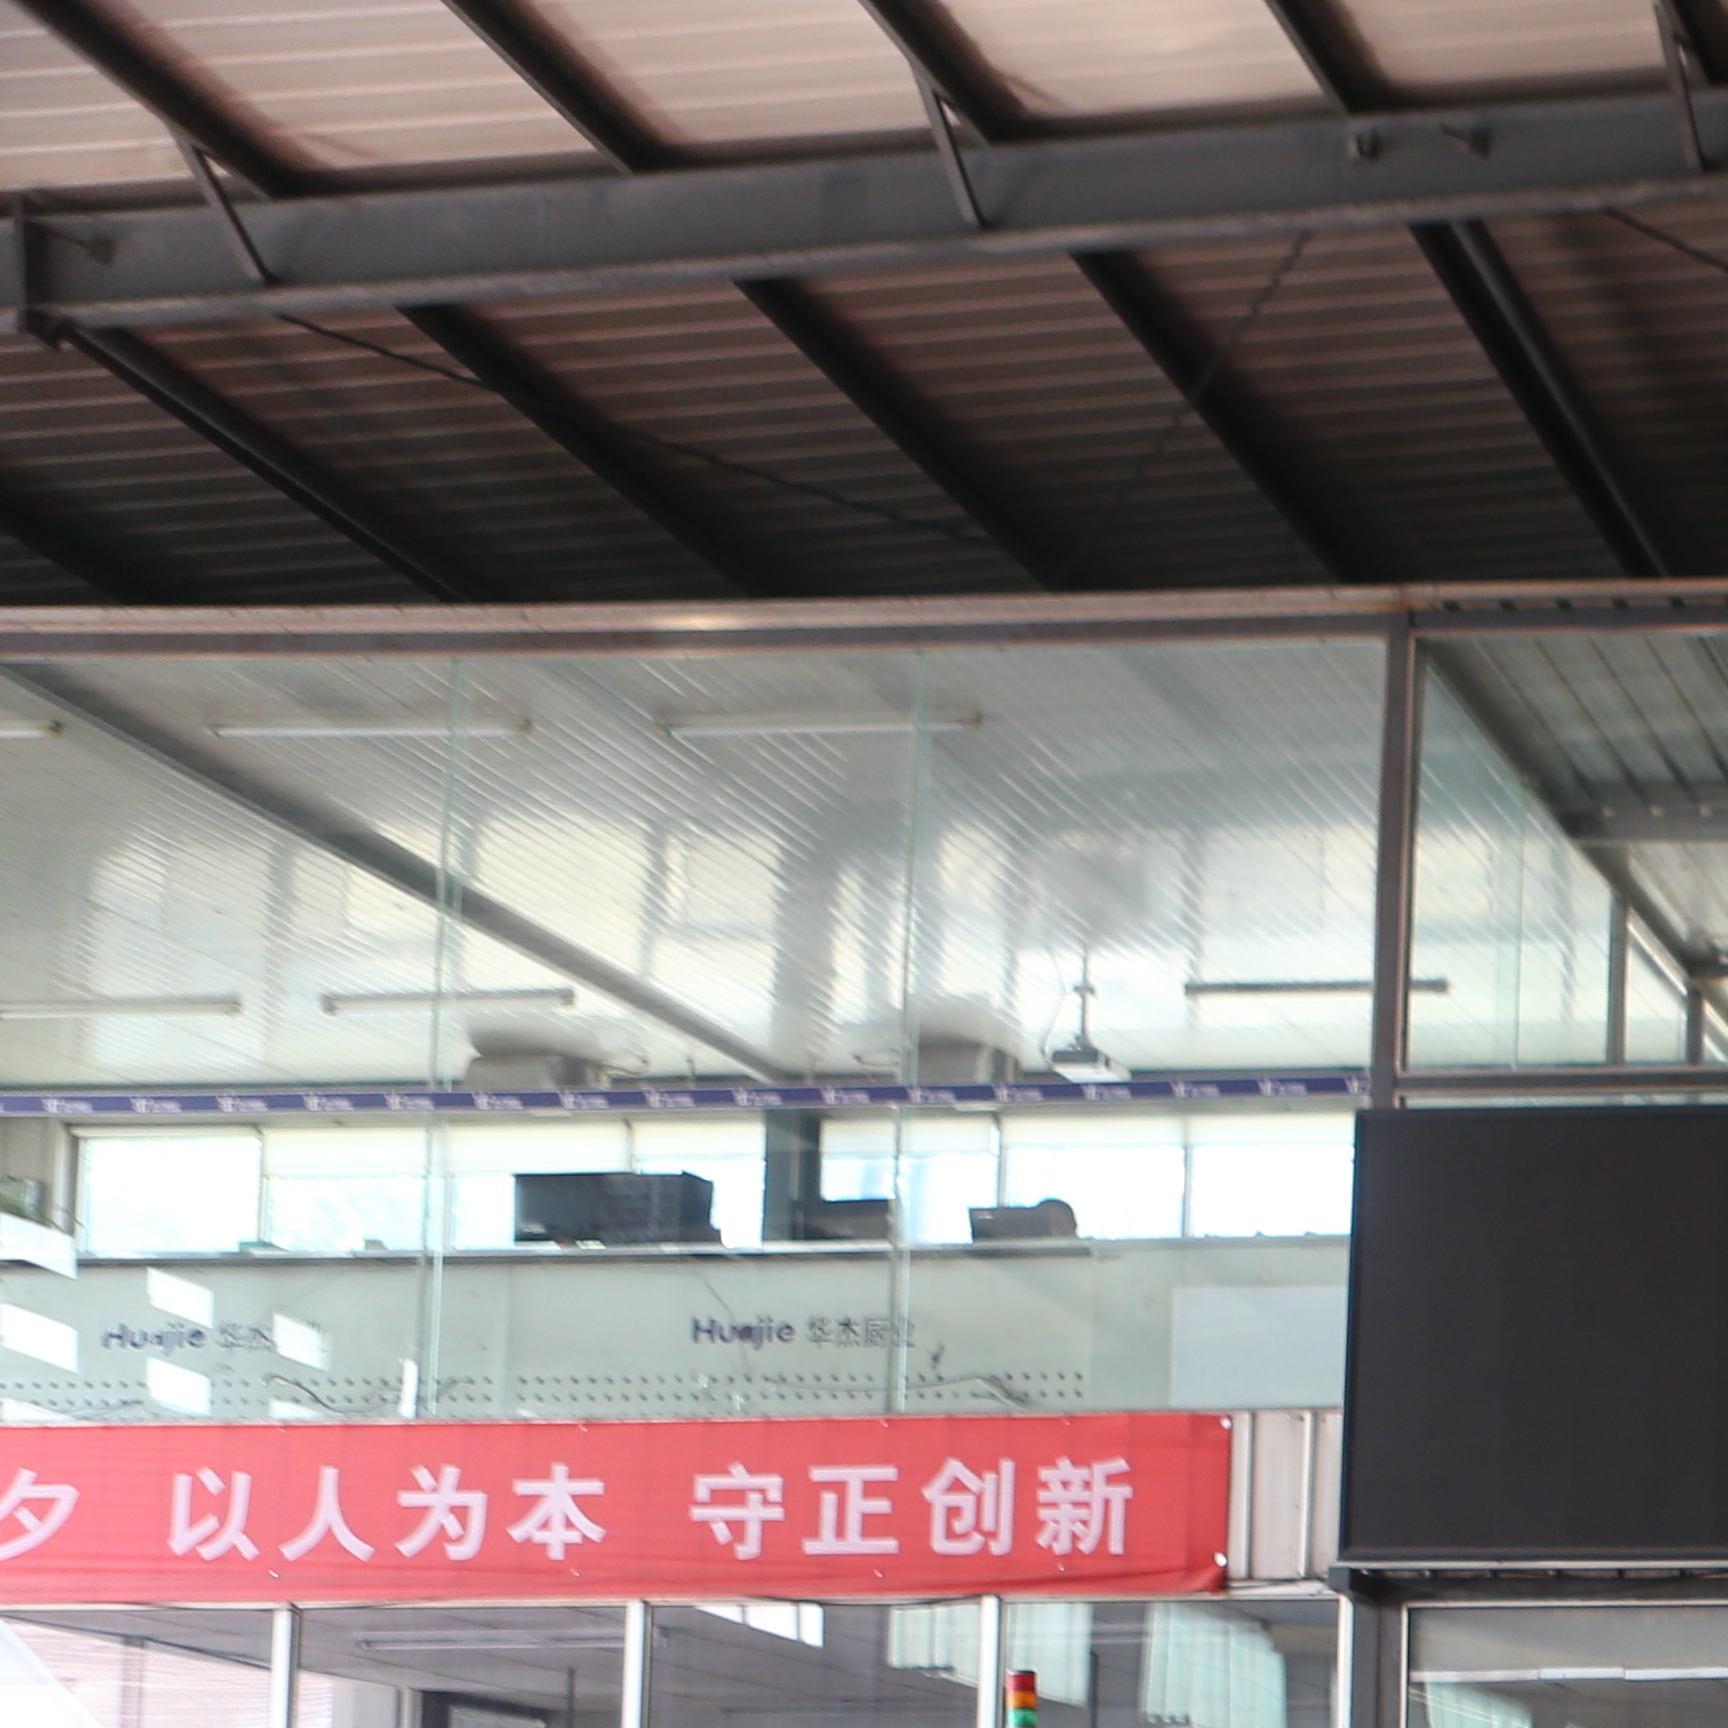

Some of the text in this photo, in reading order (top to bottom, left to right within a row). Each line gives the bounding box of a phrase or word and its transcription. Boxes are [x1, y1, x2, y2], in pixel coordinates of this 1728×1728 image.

[167, 1465, 607, 1562] 以人为本
[690, 1458, 1132, 1562] 守正创新
